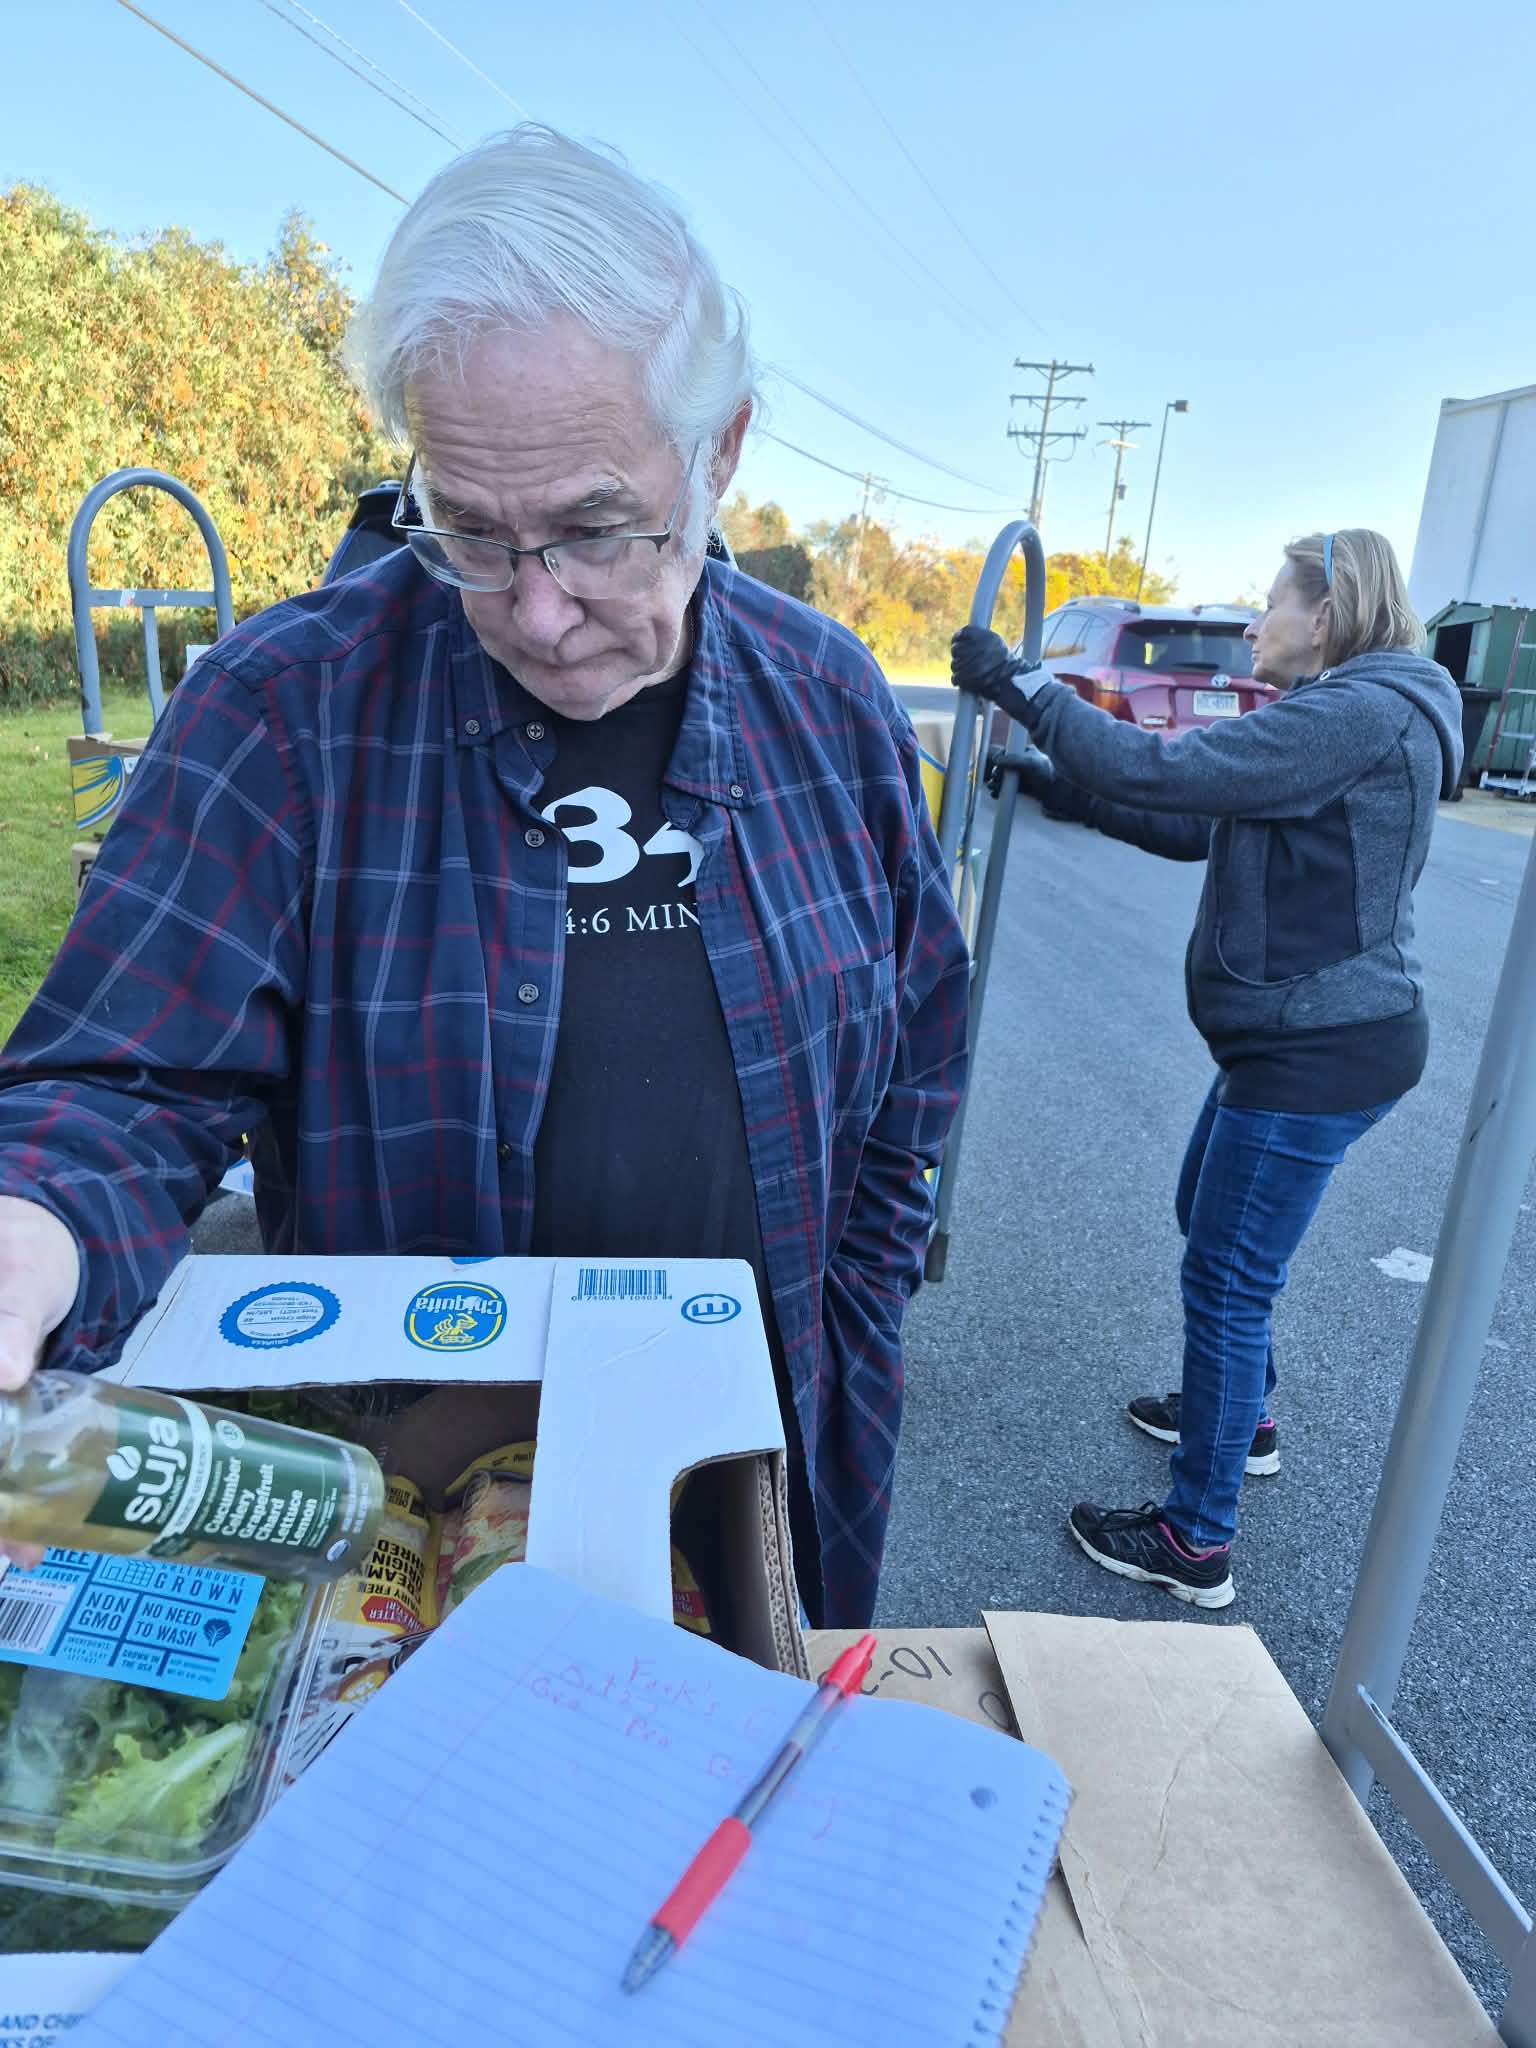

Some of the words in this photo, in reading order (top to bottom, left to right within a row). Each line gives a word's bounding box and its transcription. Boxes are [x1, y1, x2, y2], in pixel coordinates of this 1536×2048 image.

[415, 1295, 503, 1315] Chiquita
[124, 1416, 187, 1525] suja
[204, 1456, 242, 1534] Cucumber
[221, 1489, 255, 1536] Celery
[238, 1463, 274, 1538] Grapefruit
[270, 1489, 303, 1544] Lettuce
[255, 1497, 285, 1541] Chard
[286, 1499, 317, 1546] Lemon
[86, 1591, 131, 1613] NON
[154, 1572, 244, 1605] GROWN
[78, 1609, 122, 1631] GMO
[135, 1621, 152, 1638] TO
[157, 1626, 198, 1647] WASH
[142, 1602, 163, 1618] NO
[166, 1606, 202, 1626] NEED
